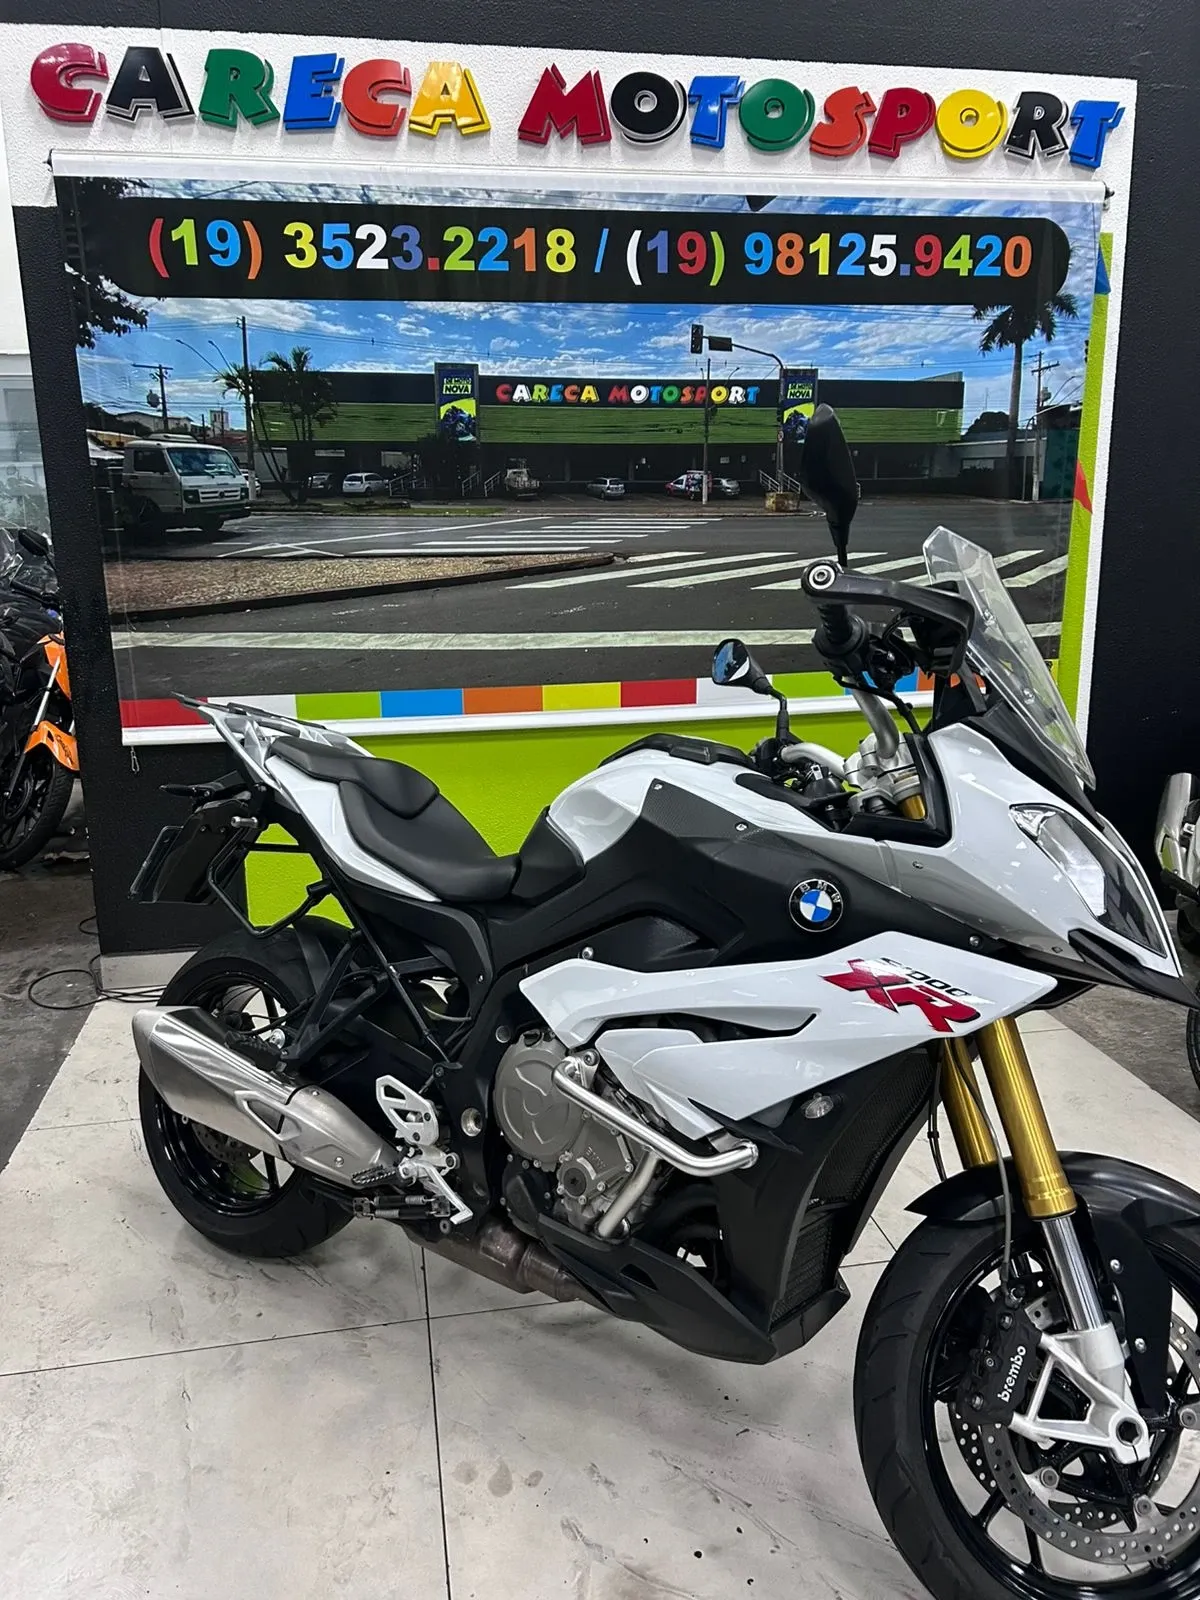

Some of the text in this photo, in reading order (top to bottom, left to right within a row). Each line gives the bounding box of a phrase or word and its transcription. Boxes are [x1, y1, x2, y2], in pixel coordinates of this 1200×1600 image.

[30, 42, 1125, 169] CARECA MOTOSPORT
[149, 218, 263, 280] (19)
[283, 221, 577, 273] 3523.2218
[626, 229, 725, 286] (19)
[744, 231, 1032, 278] 98125.9420
[445, 385, 470, 393] NOVA
[496, 383, 760, 405] CARECA MOTOSPORT
[789, 390, 810, 398] NOVA
[800, 880, 841, 903] BMW
[819, 958, 982, 1033] XR
[997, 1345, 1027, 1403] brembo
